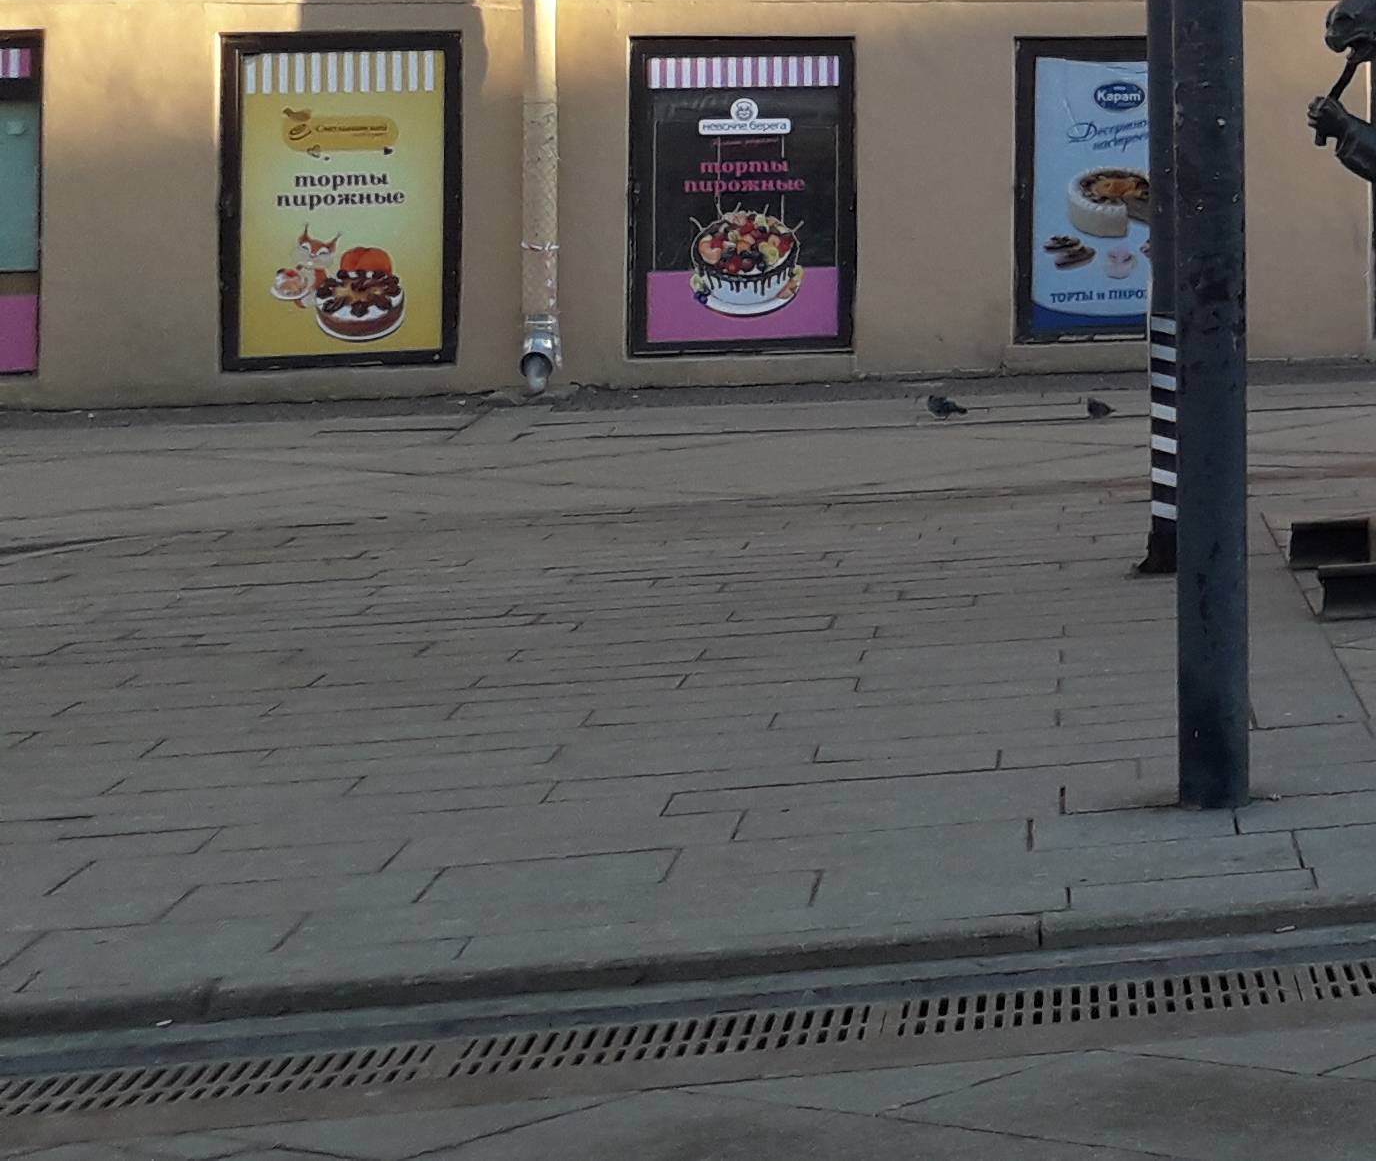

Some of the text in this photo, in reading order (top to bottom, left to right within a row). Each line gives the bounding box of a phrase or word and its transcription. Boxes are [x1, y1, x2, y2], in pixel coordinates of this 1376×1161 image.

[748, 120, 788, 132] берега
[700, 160, 790, 177] торты
[294, 173, 389, 191] торты
[683, 177, 806, 195] пирожные
[277, 191, 406, 211] пирожные
[1050, 289, 1094, 304] ТОРТЫ
[1108, 288, 1147, 301] ПИРО
